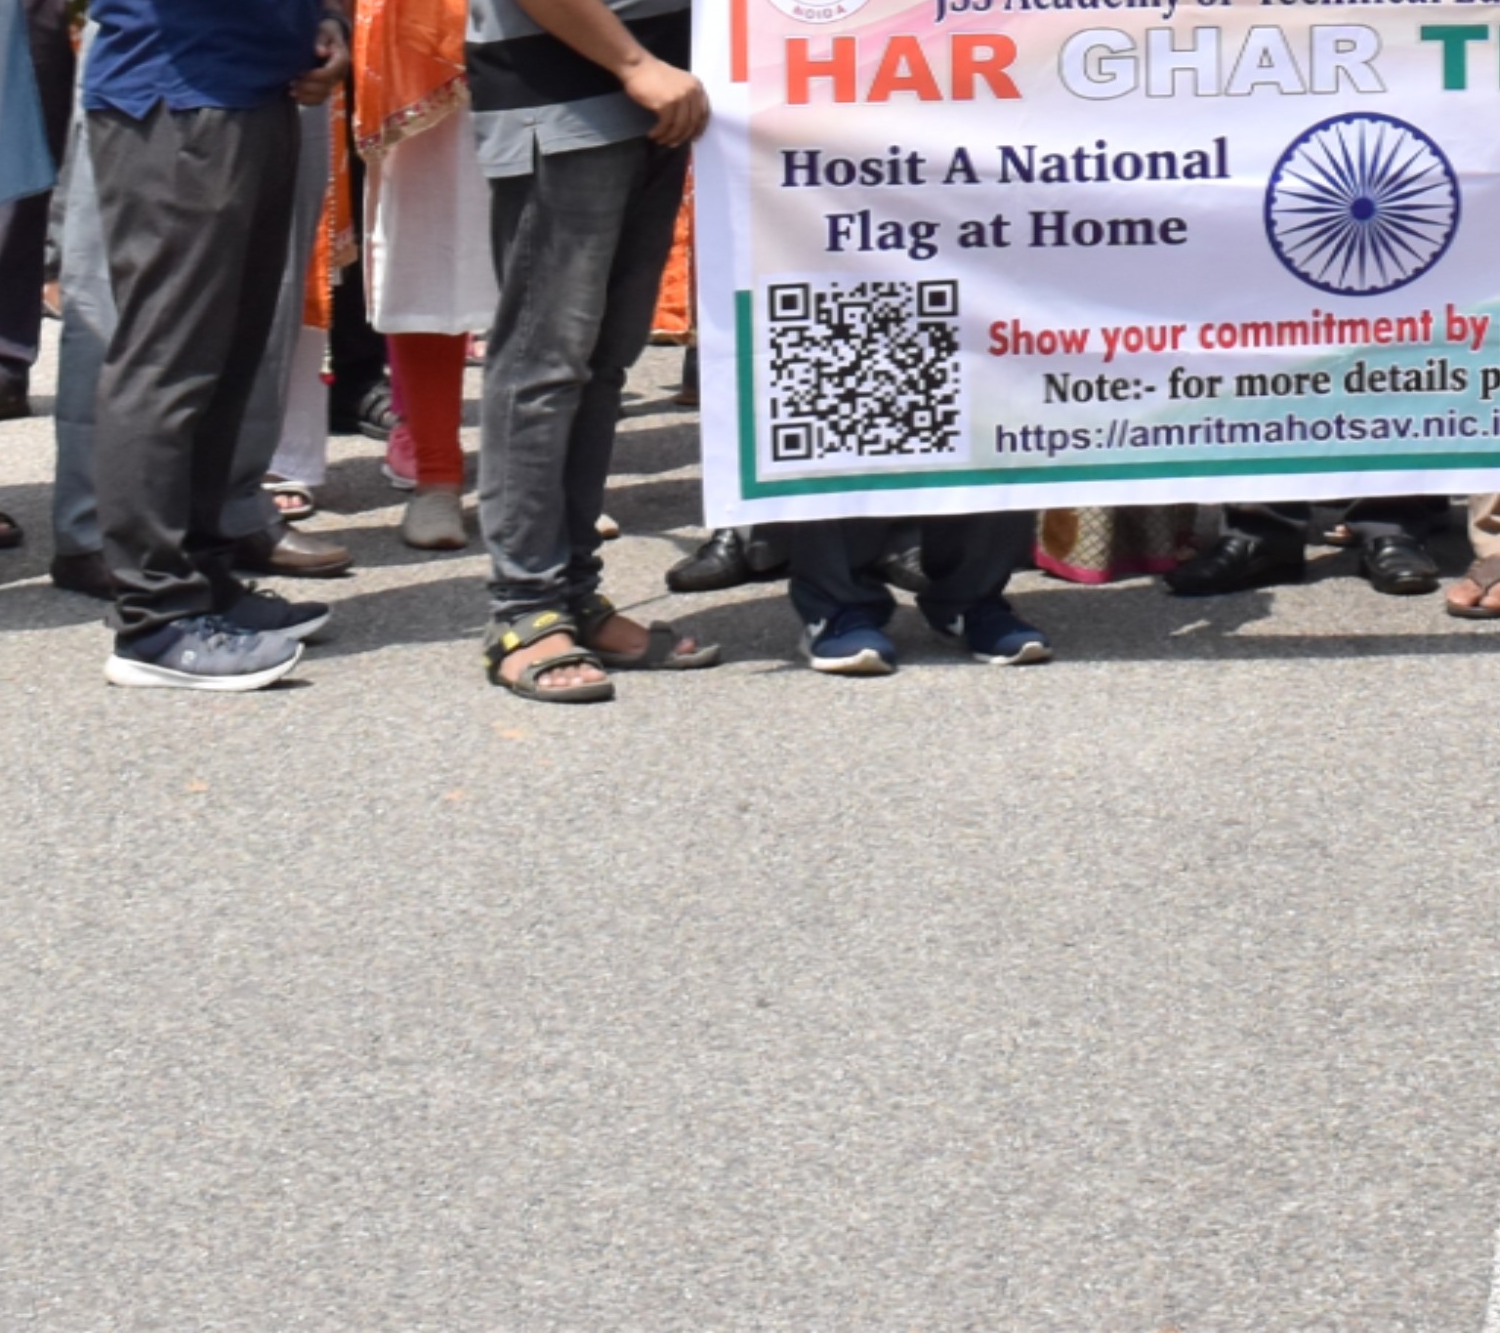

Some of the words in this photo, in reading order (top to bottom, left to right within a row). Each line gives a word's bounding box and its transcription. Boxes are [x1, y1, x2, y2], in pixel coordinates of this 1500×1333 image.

[784, 32, 1022, 105] HAR
[1057, 24, 1389, 101] GHAR
[780, 145, 927, 189] Hosit
[942, 146, 982, 185] A
[997, 136, 1231, 185] National
[825, 209, 940, 260] Flag
[957, 213, 1012, 249] at
[1028, 209, 1189, 248] Home
[987, 319, 1090, 358] Show
[1100, 321, 1187, 363] your
[1198, 307, 1434, 351] commitment
[1444, 302, 1490, 351] by
[1043, 372, 1158, 405] Note:-
[1168, 367, 1223, 401] for
[1233, 371, 1332, 399] more
[1343, 360, 1468, 395] details
